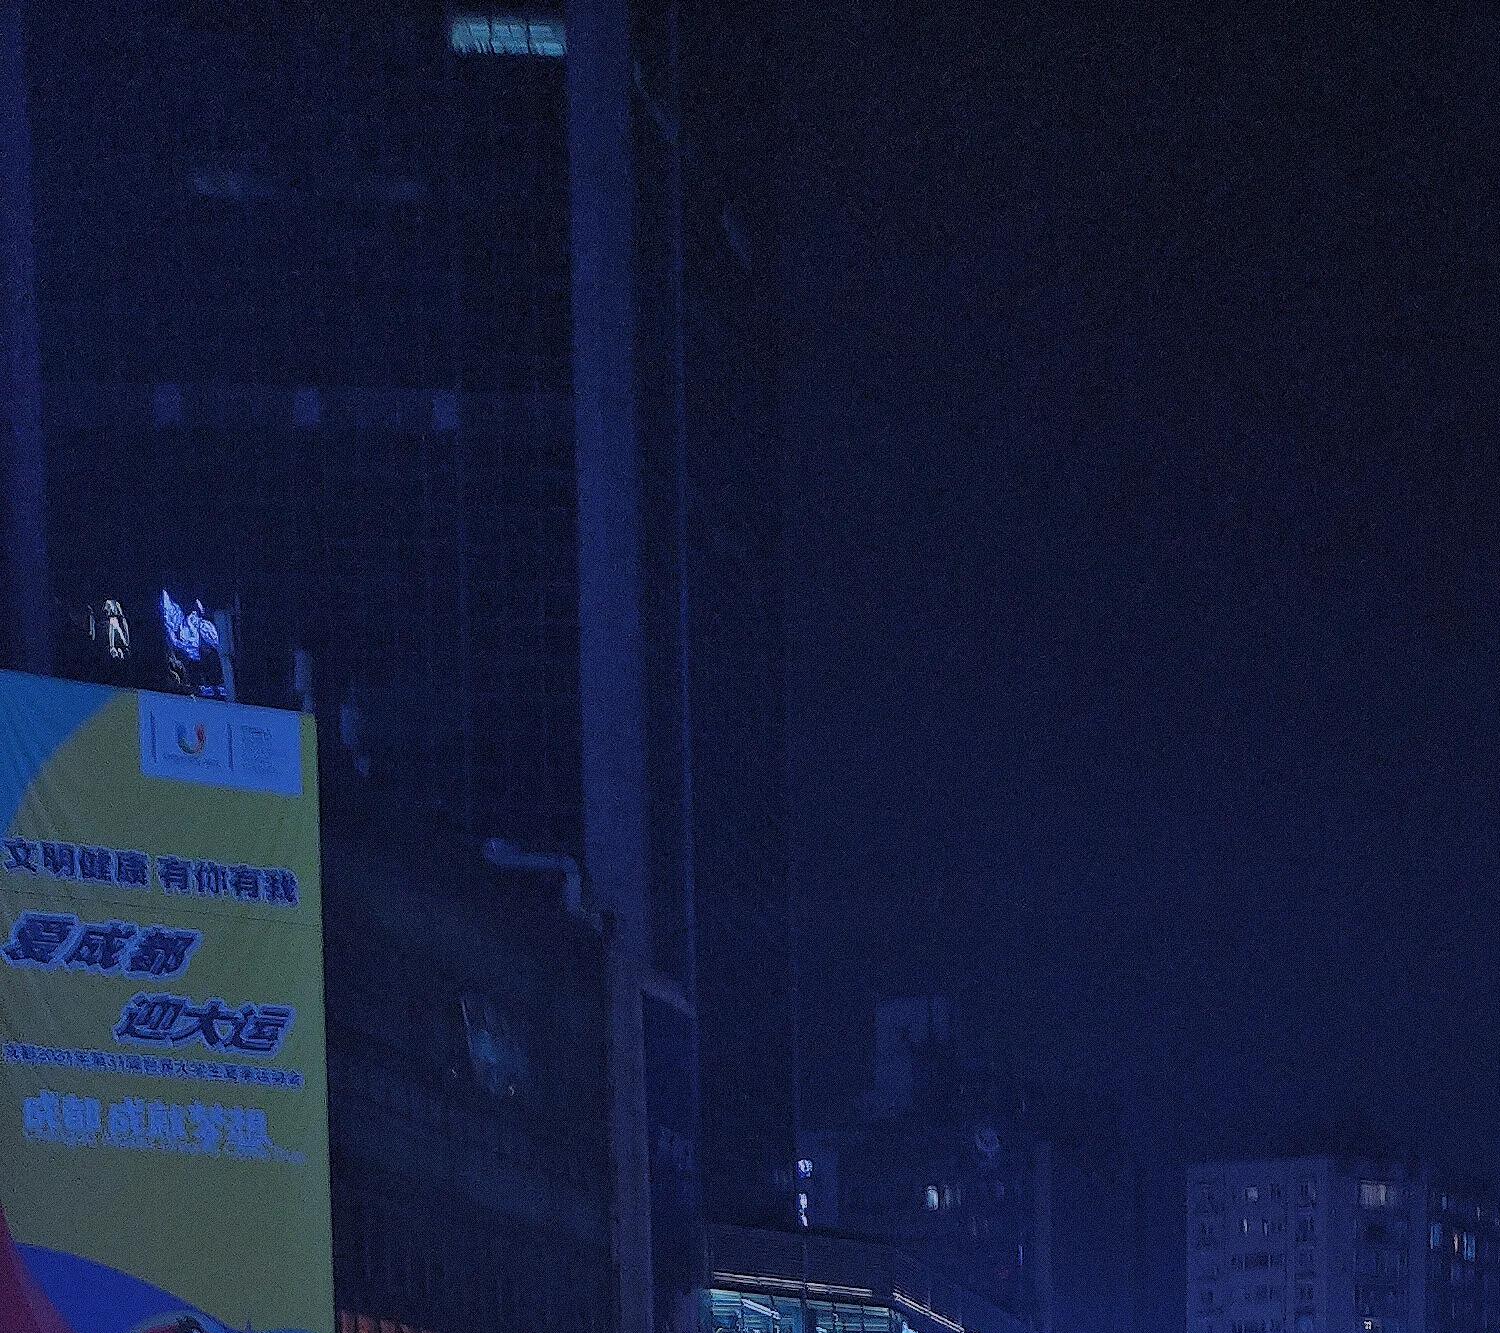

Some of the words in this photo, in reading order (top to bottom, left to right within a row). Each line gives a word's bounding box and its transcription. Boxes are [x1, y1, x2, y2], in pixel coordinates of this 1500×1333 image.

[3, 838, 149, 887] 文明健康
[158, 854, 299, 905] 有你有我
[6, 912, 197, 977] 爱成都
[119, 993, 295, 1053] 迎大运
